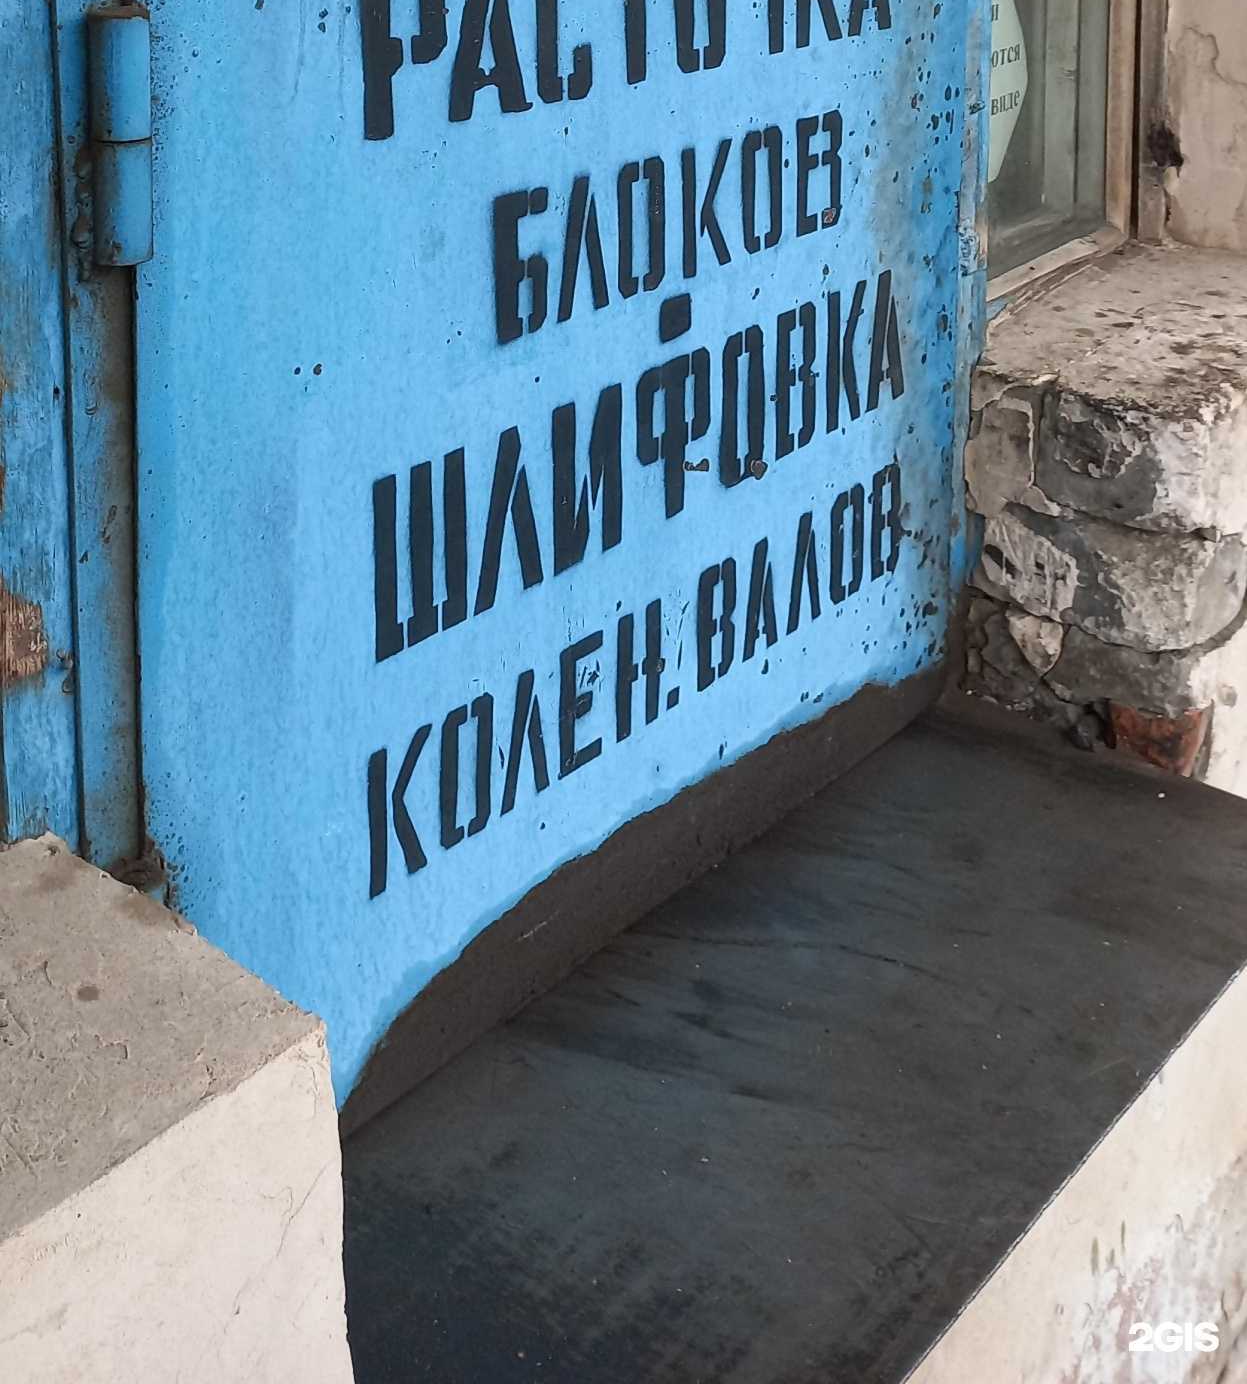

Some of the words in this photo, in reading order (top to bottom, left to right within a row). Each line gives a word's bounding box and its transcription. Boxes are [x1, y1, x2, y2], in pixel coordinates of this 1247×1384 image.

[492, 109, 845, 346] БЛОКОВ
[990, 91, 1021, 116] виде
[372, 269, 906, 664] ШЛИФОВКА
[367, 596, 681, 900] КОЛЕН.
[696, 462, 903, 694] ВАЛОВ
